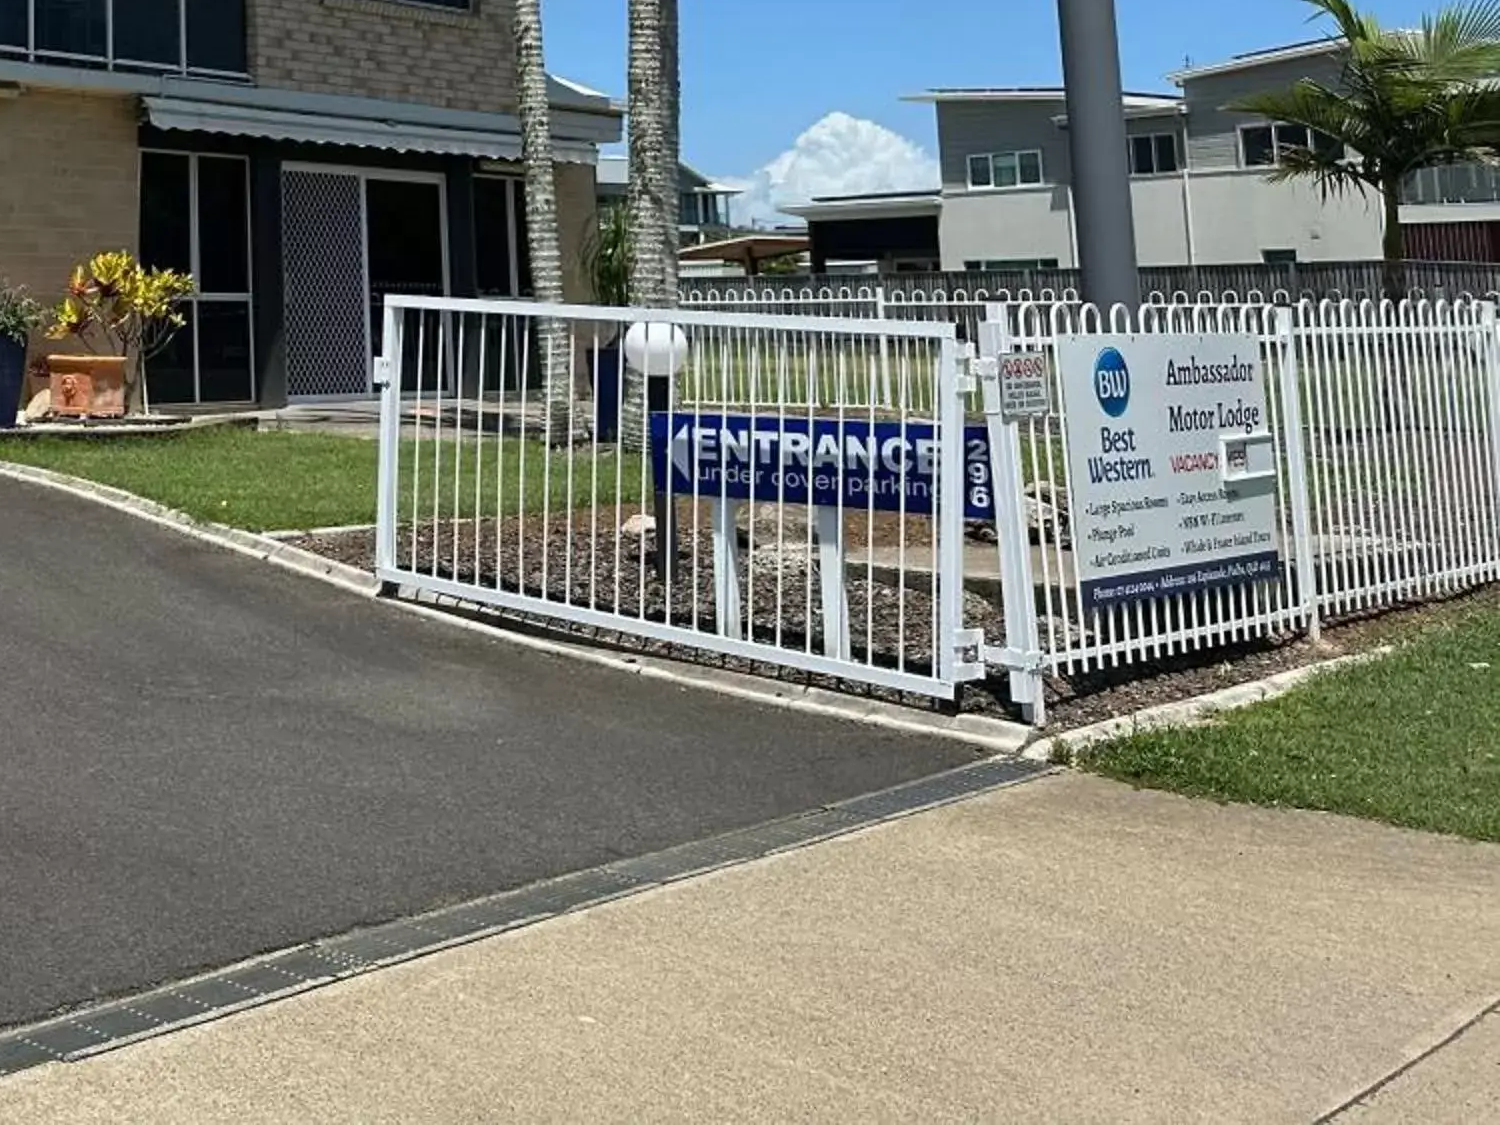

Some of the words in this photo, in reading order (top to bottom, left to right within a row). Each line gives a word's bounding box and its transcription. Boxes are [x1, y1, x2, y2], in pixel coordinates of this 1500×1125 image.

[1098, 368, 1126, 398] BW
[1166, 354, 1253, 385] Ambassador
[1169, 405, 1214, 432] Motor
[1218, 399, 1259, 433] Lodge
[694, 428, 942, 474] ENTRANCE
[1101, 427, 1136, 453] Best
[966, 439, 991, 508] 296
[1088, 457, 1151, 483] Western
